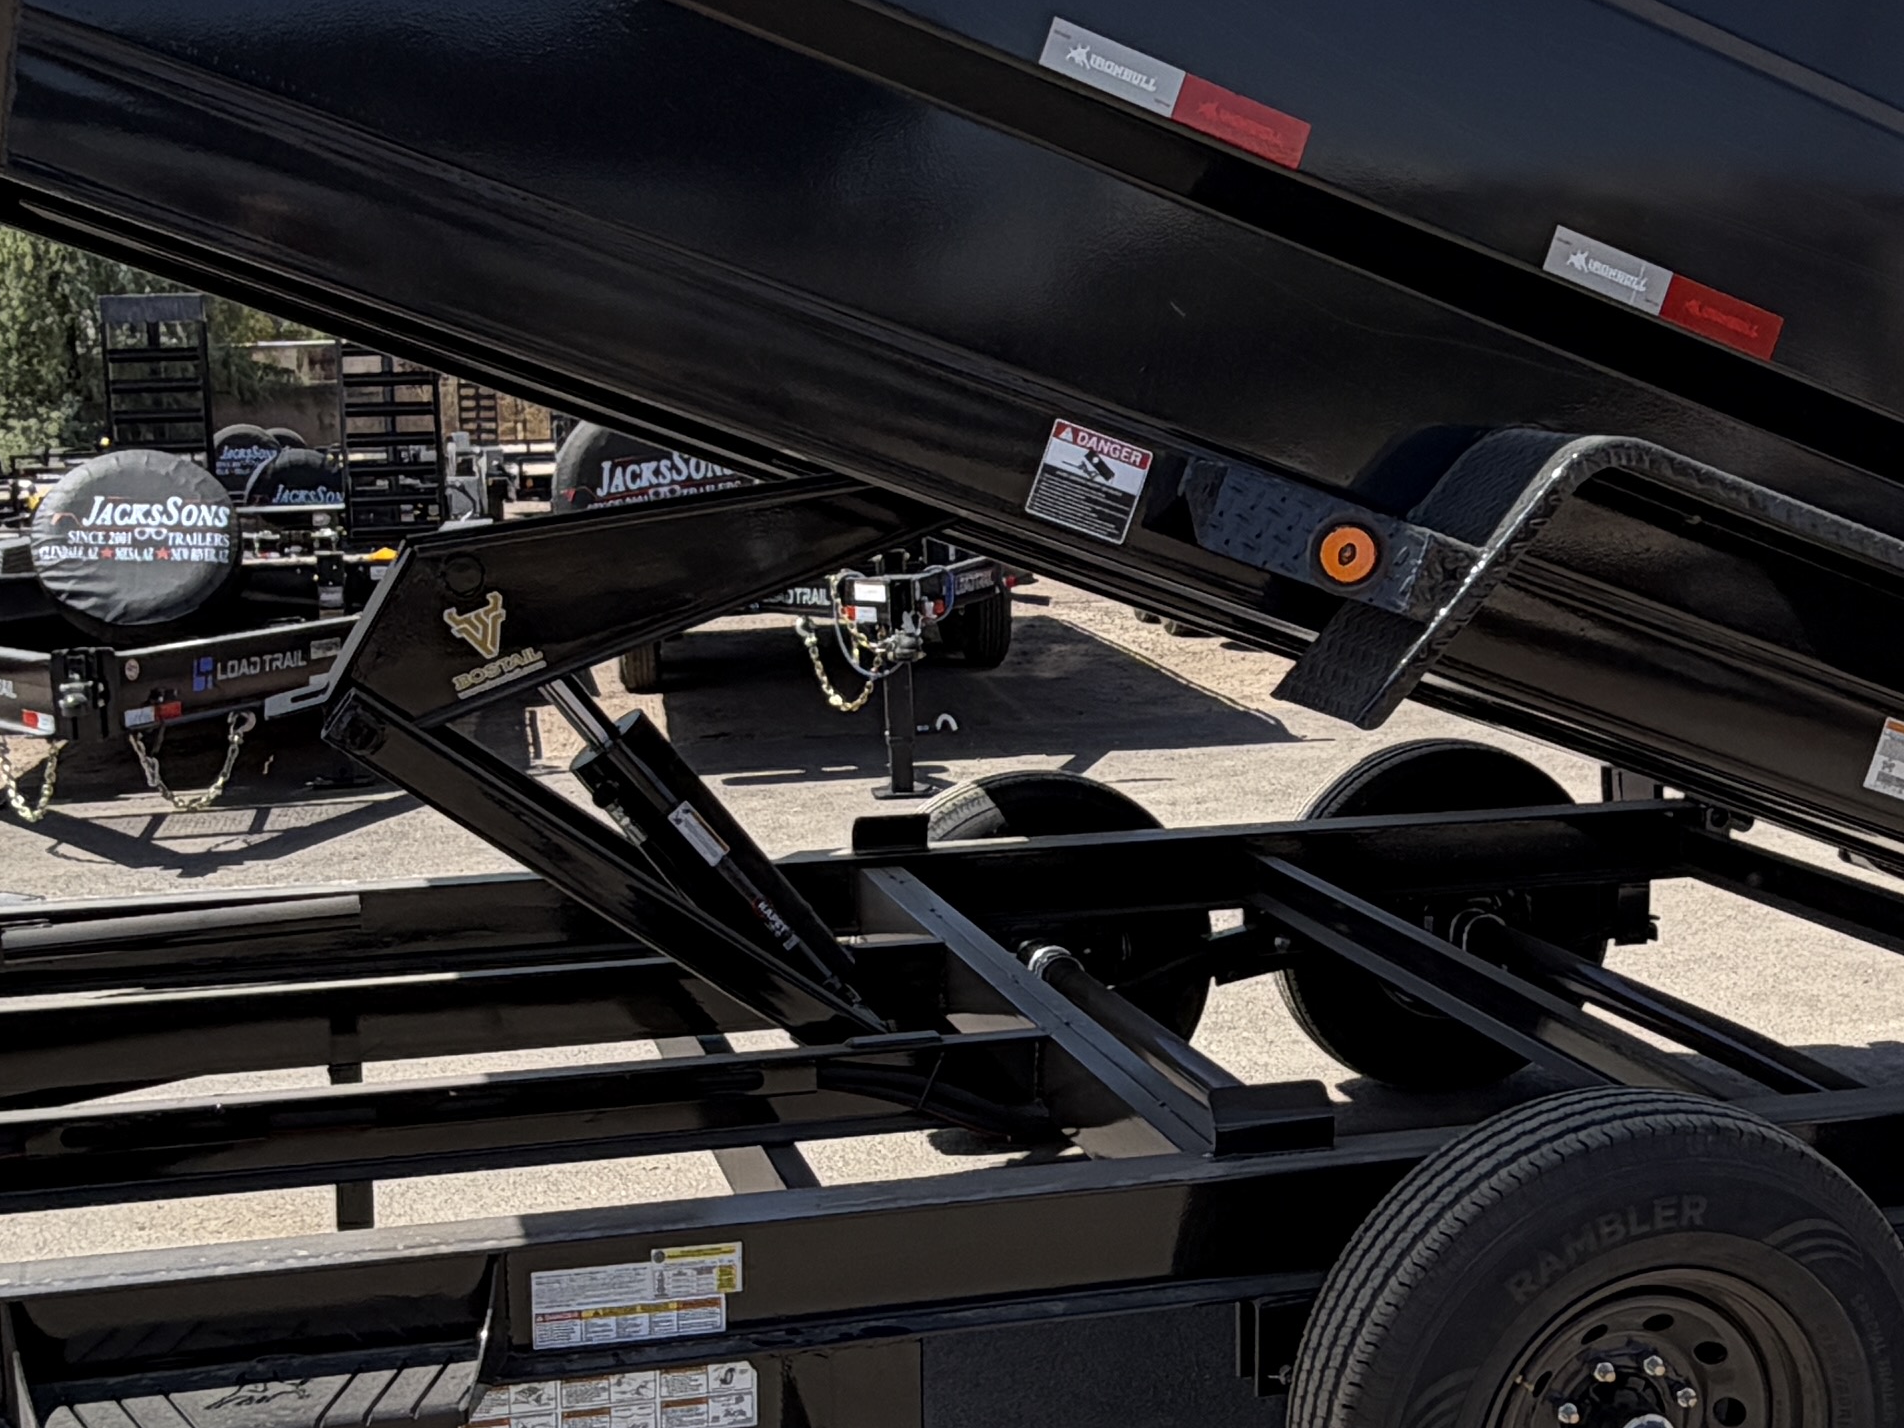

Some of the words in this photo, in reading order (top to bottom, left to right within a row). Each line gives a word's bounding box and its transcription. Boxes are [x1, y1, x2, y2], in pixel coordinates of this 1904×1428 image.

[220, 445, 279, 461] JACKSSON
[1075, 431, 1144, 467] DANGER
[272, 483, 346, 504] JACKSSON
[67, 529, 106, 546] SINCE
[167, 531, 231, 548] TRAILERS
[795, 586, 832, 607] TRAIL
[216, 658, 262, 681] LOAD
[261, 649, 308, 673] TRAIL
[1502, 1192, 1710, 1306] RAMBLER
